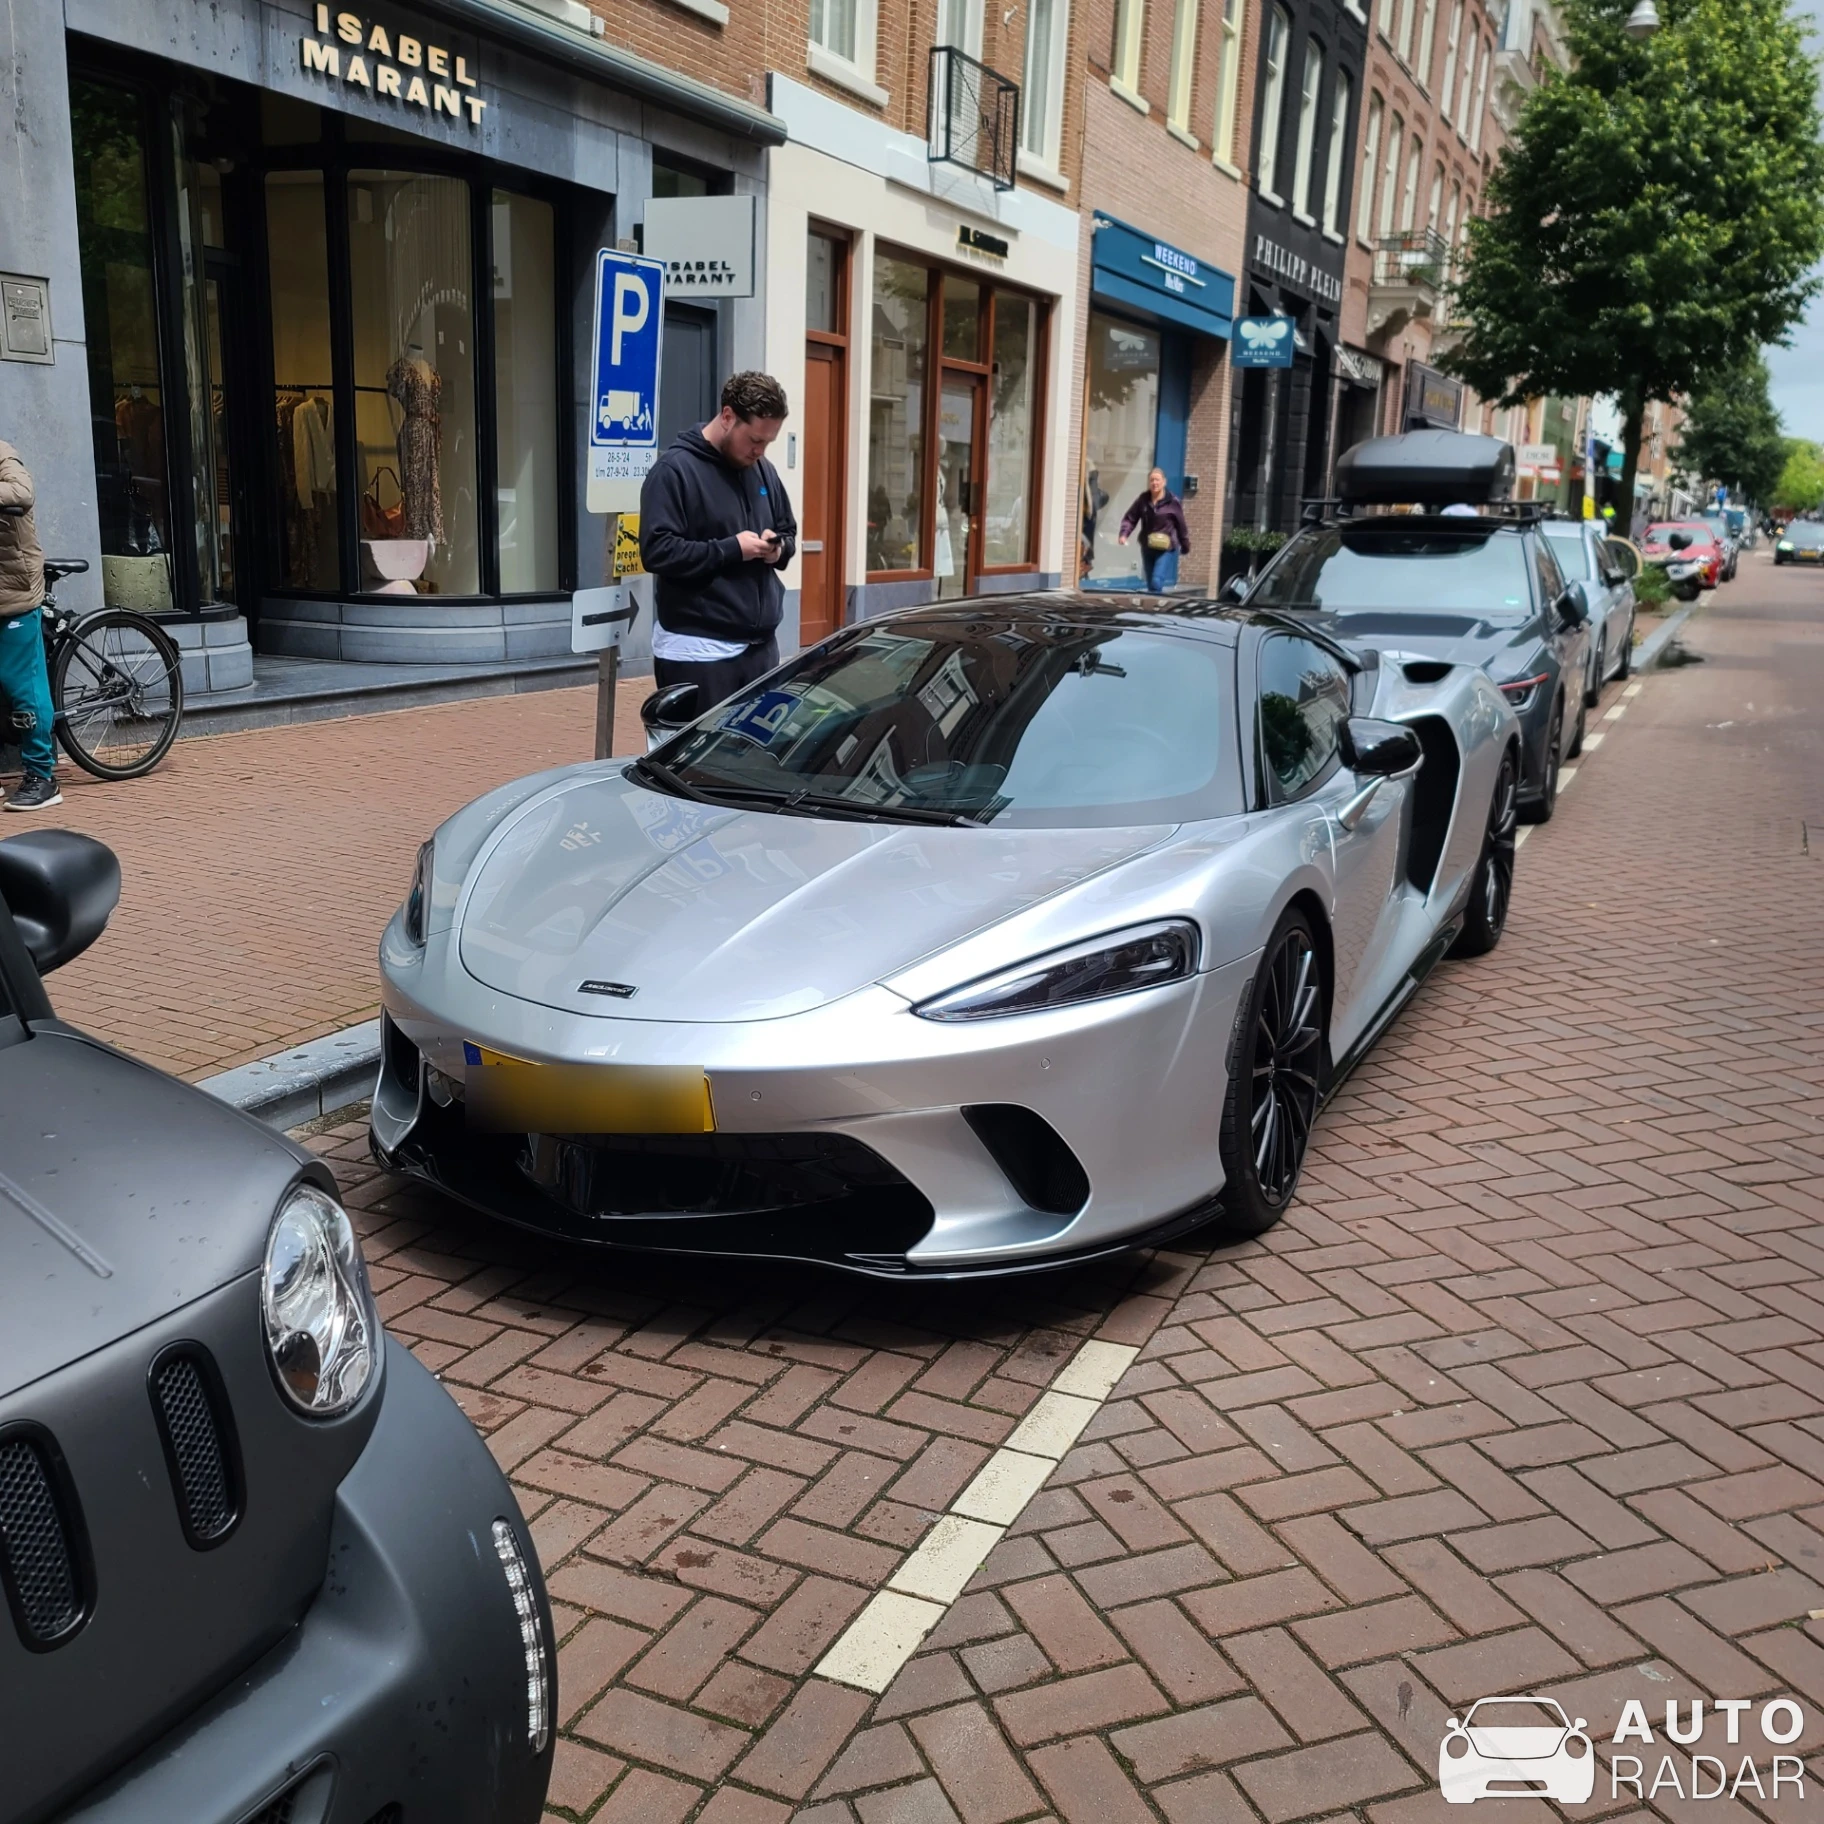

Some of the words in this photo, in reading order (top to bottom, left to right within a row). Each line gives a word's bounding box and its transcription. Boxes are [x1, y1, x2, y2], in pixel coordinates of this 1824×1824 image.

[302, 37, 487, 125] MARANT
[316, 3, 477, 88] ISABEL
[1154, 243, 1197, 275] WEEKEND
[1254, 234, 1308, 284] PHILIPP
[1308, 265, 1341, 303] PLEIN
[611, 271, 650, 366] P
